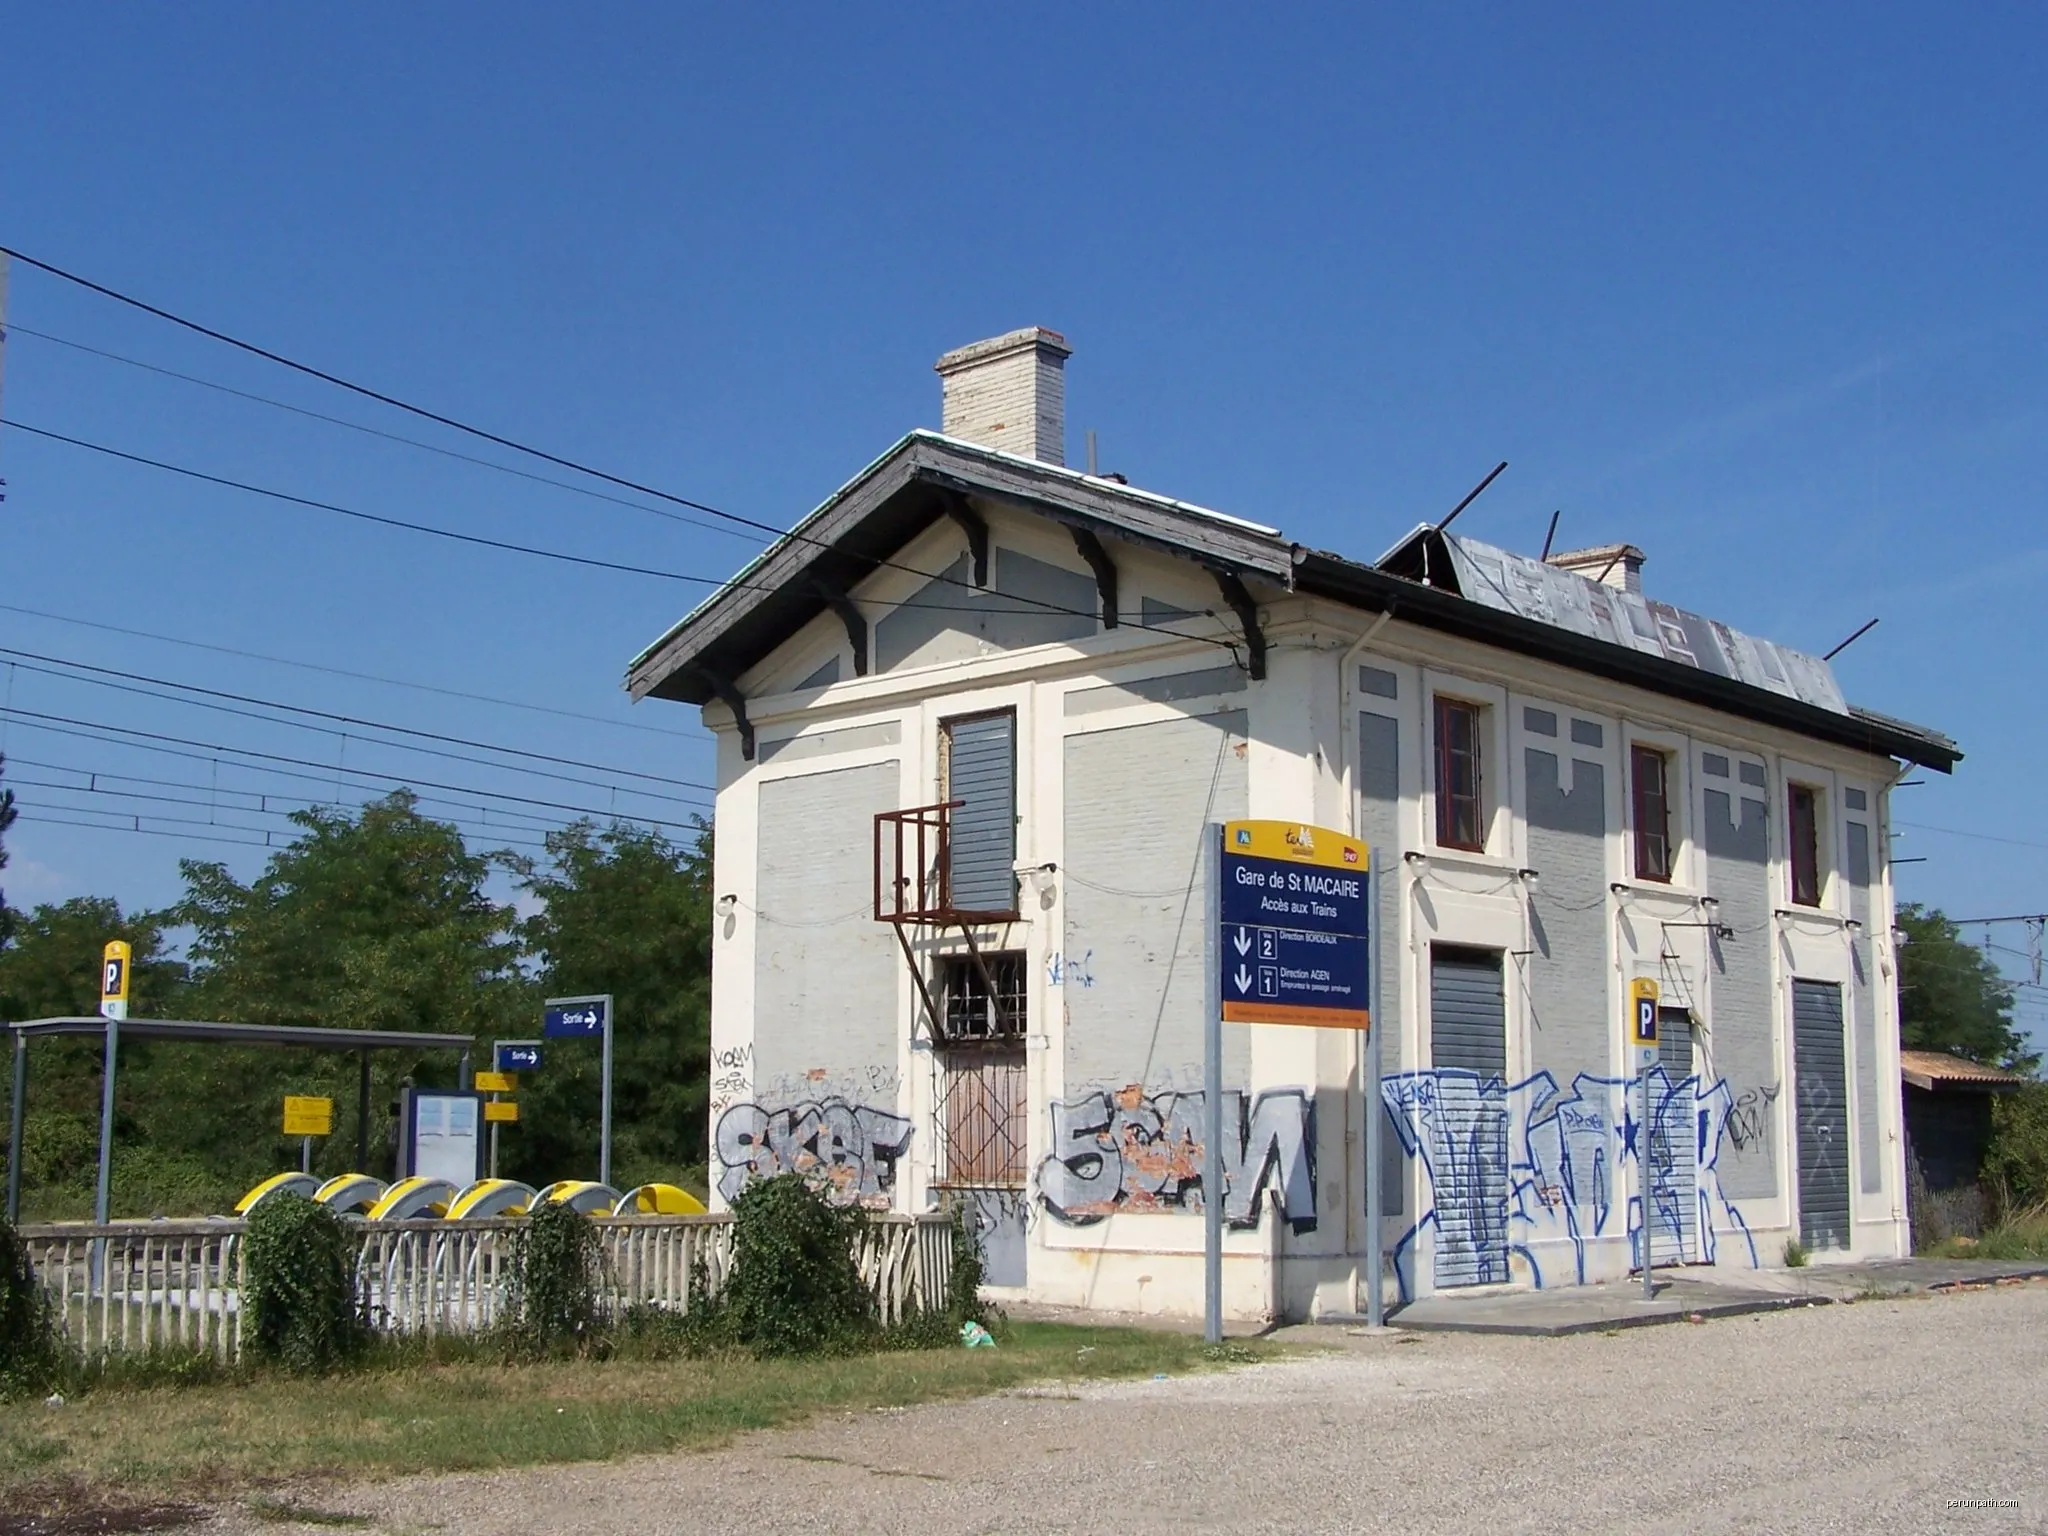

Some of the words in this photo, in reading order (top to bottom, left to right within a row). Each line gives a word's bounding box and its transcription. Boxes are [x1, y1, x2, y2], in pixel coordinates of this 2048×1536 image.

[1236, 866, 1265, 886] Gare
[1269, 871, 1284, 889] de
[1288, 873, 1302, 891] St
[1304, 875, 1359, 899] MACAIRE
[1261, 896, 1289, 913] Accès
[1291, 902, 1308, 914] aux
[1310, 901, 1338, 918] Trains
[1263, 940, 1272, 956] 2
[106, 963, 118, 992] P
[1280, 967, 1309, 979] Direction
[1310, 969, 1330, 981] AGEN
[1264, 977, 1270, 993] 1
[563, 1012, 584, 1025] Sortie
[1641, 1002, 1653, 1036] P
[512, 1051, 528, 1060] Sortie
